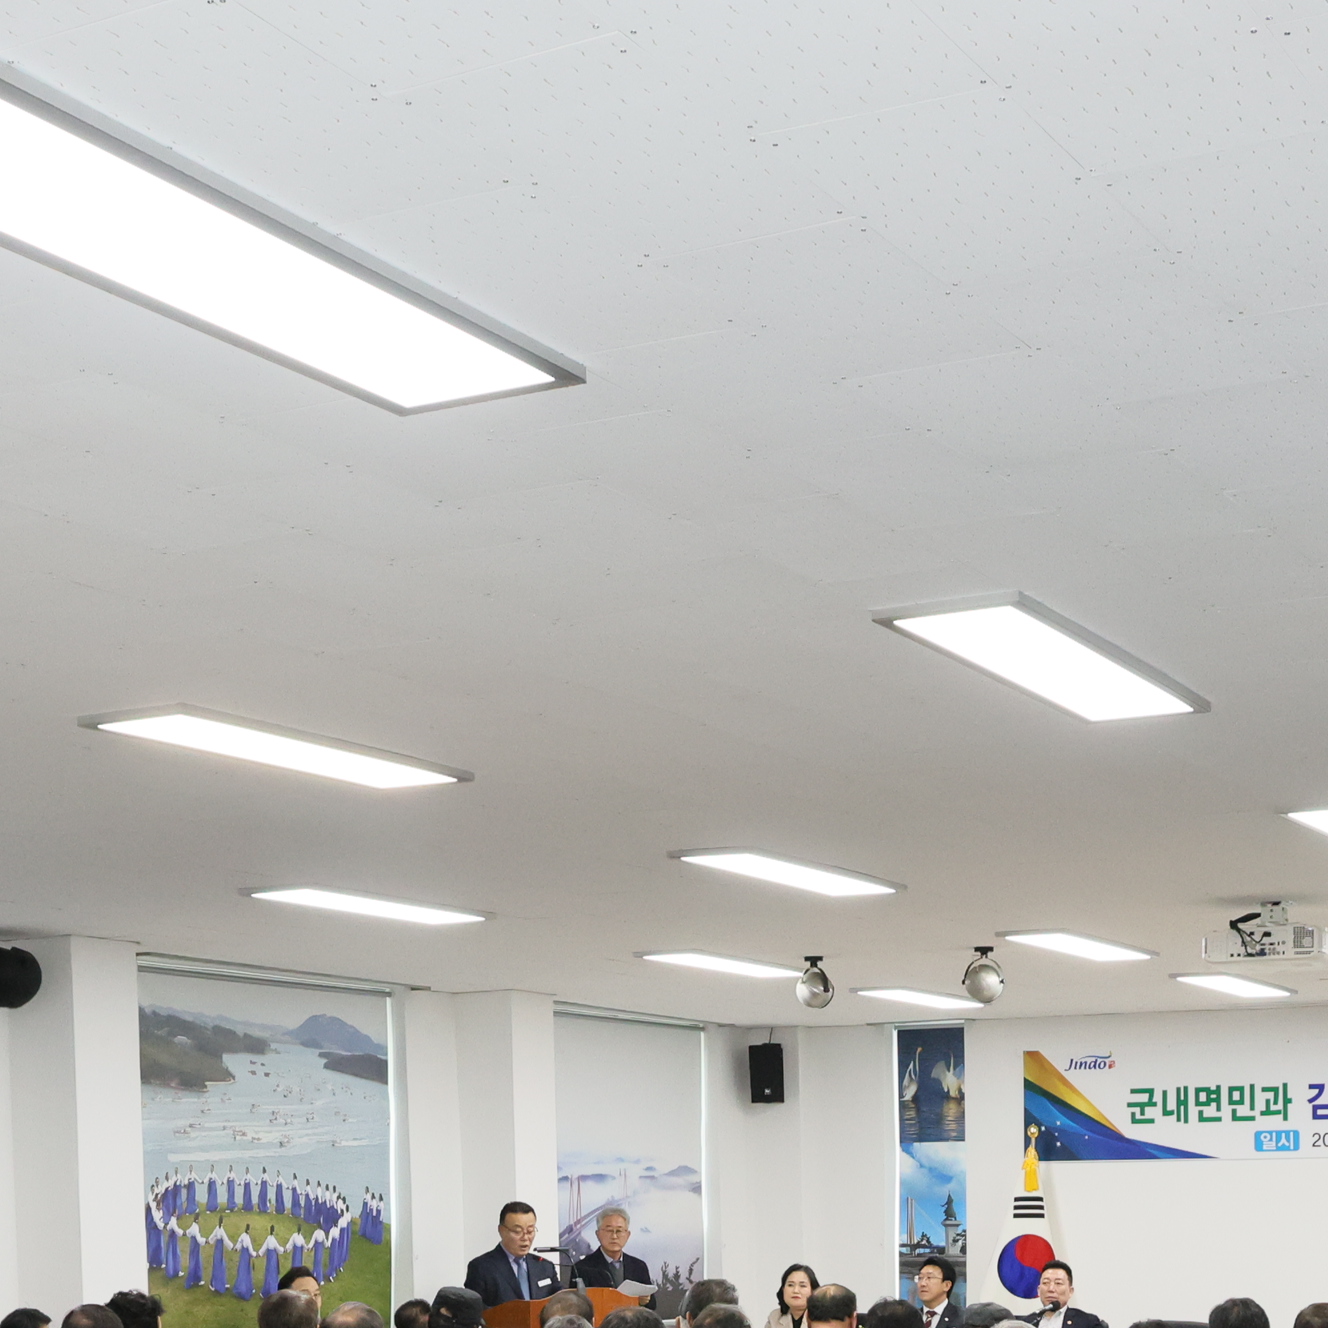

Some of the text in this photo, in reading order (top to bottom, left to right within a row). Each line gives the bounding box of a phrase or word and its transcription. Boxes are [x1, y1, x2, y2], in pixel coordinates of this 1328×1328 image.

[1064, 1058, 1107, 1072] Jindo
[1127, 1082, 1293, 1124] 군내면민과
[1259, 1132, 1295, 1150] 일시
